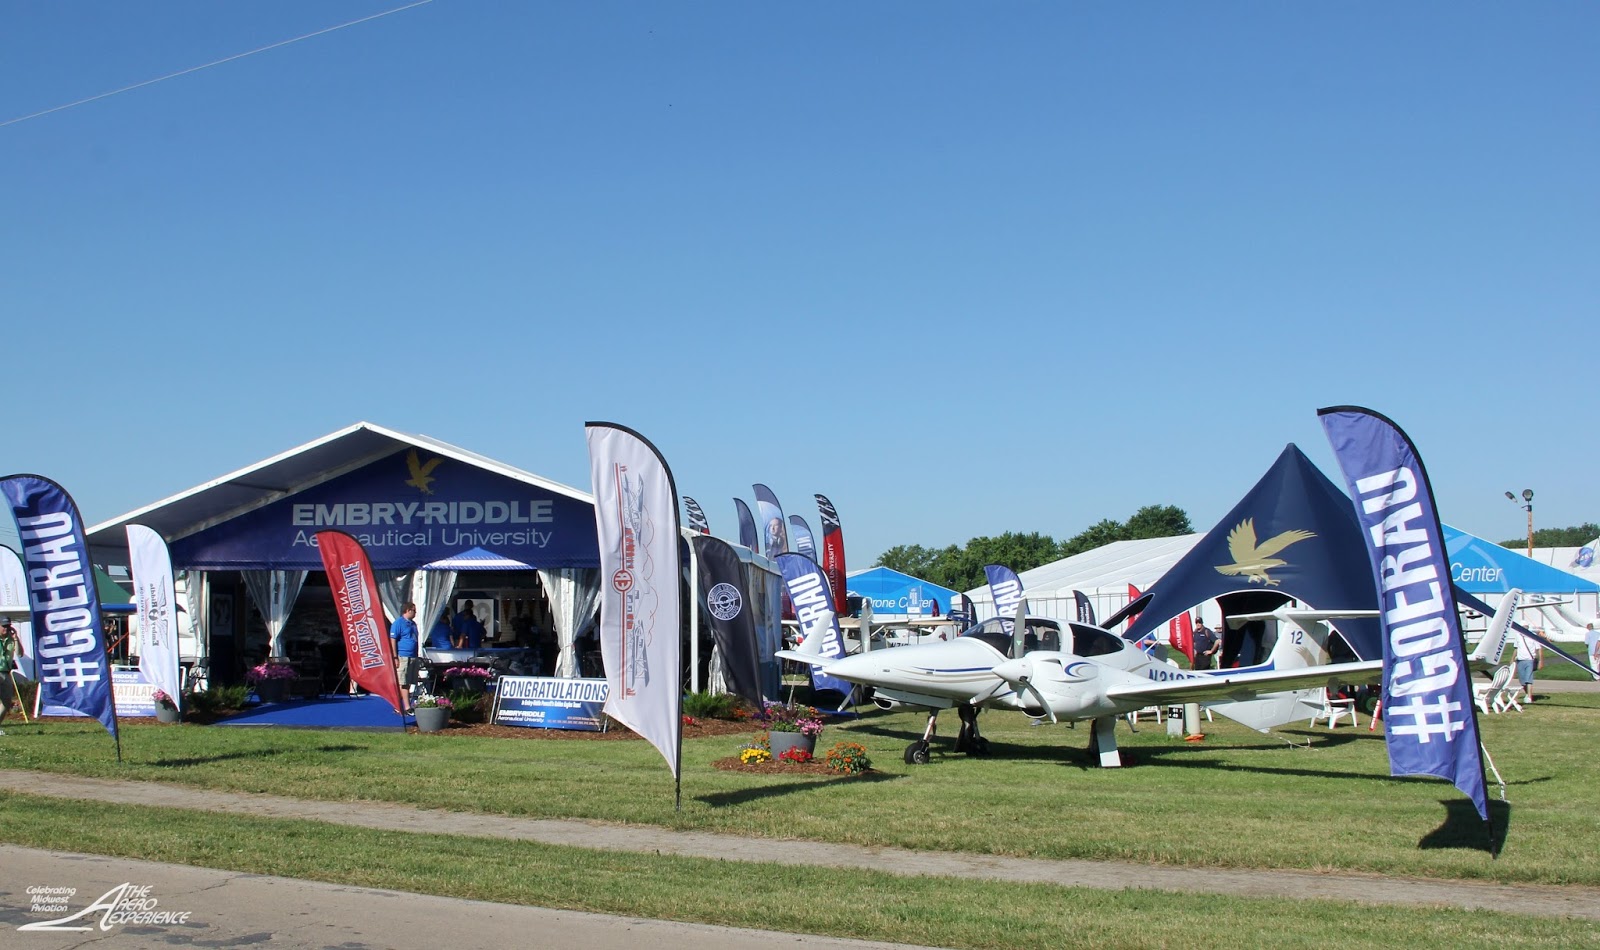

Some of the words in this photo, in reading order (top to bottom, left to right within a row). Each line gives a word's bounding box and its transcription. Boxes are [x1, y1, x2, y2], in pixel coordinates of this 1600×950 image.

[292, 500, 553, 526] EMBRY-RIDDLE
[292, 528, 432, 547] Aeautical
[442, 528, 553, 548] University
[1451, 562, 1503, 582] Center
[18, 511, 101, 688] #GOERAU
[1355, 466, 1464, 743] #GOERAU
[1175, 615, 1183, 649] FLYLIBERTYU
[1291, 631, 1303, 644] 12
[502, 680, 608, 701] CONGRATULATIONS
